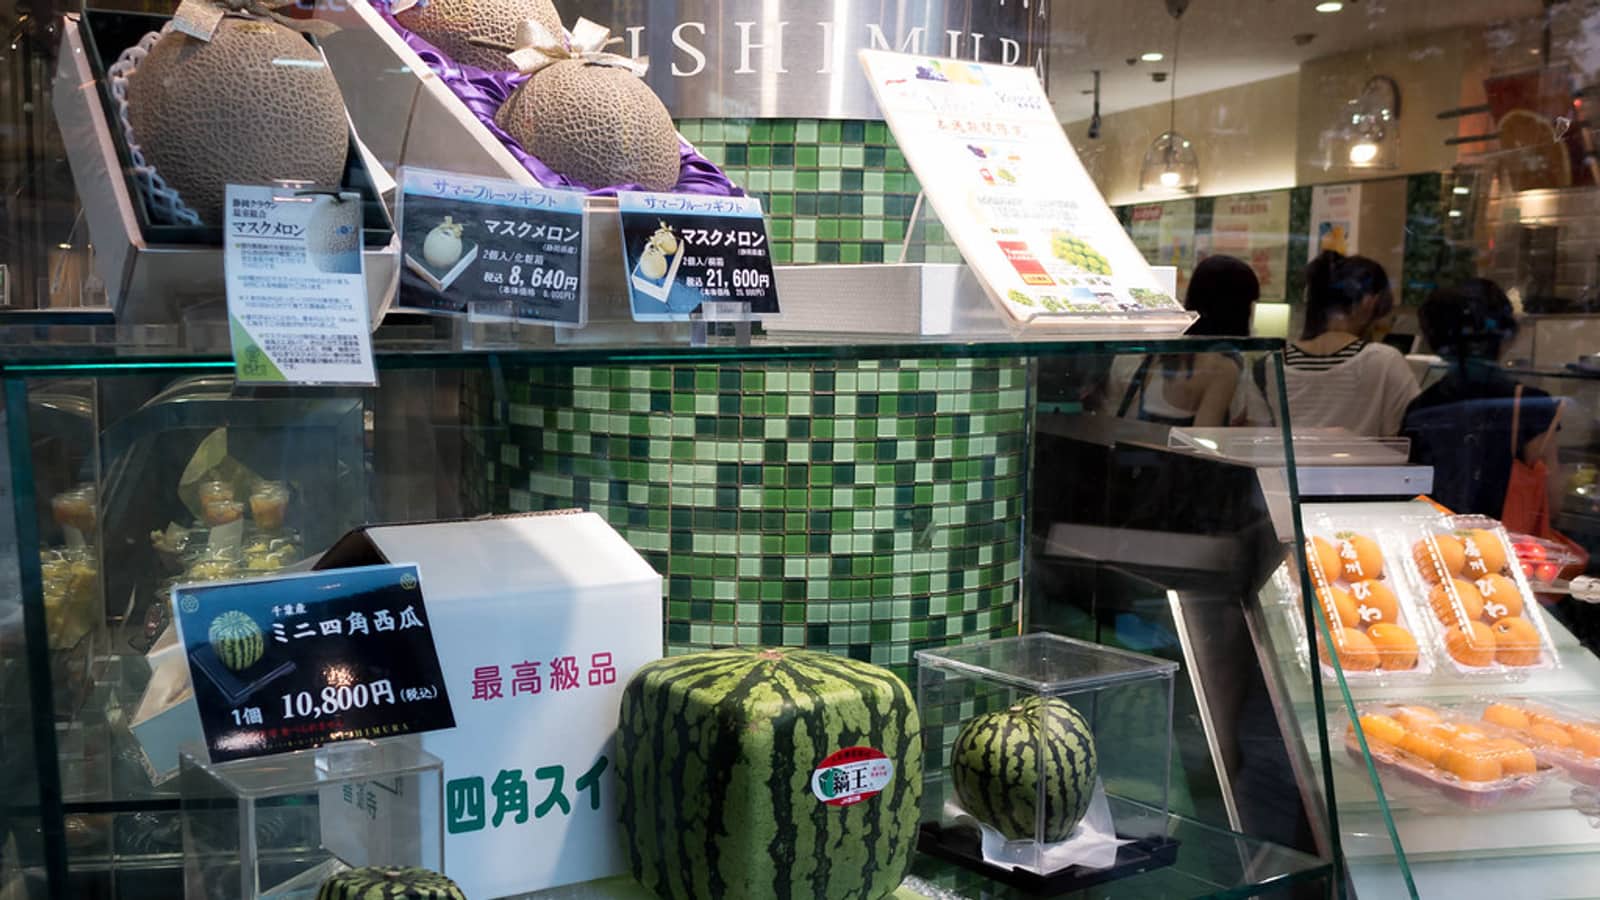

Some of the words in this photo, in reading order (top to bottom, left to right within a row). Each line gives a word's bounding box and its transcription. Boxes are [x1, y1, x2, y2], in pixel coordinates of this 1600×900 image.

[433, 179, 557, 207] サマーフルーツギフト
[644, 198, 743, 213] サマーフルーツギフト
[232, 220, 306, 237] マスクメロン
[485, 219, 580, 243] マスクメロン
[681, 228, 765, 248] マスクメロン
[483, 271, 504, 284] 税込
[706, 268, 770, 288] 21,600円
[271, 604, 424, 644] ミニ四角西瓜
[471, 652, 616, 701] 最高級品
[231, 705, 264, 727] 1個
[281, 679, 396, 720] 10,800円
[399, 684, 438, 704] (税込)
[446, 755, 609, 834] 四角スイ
